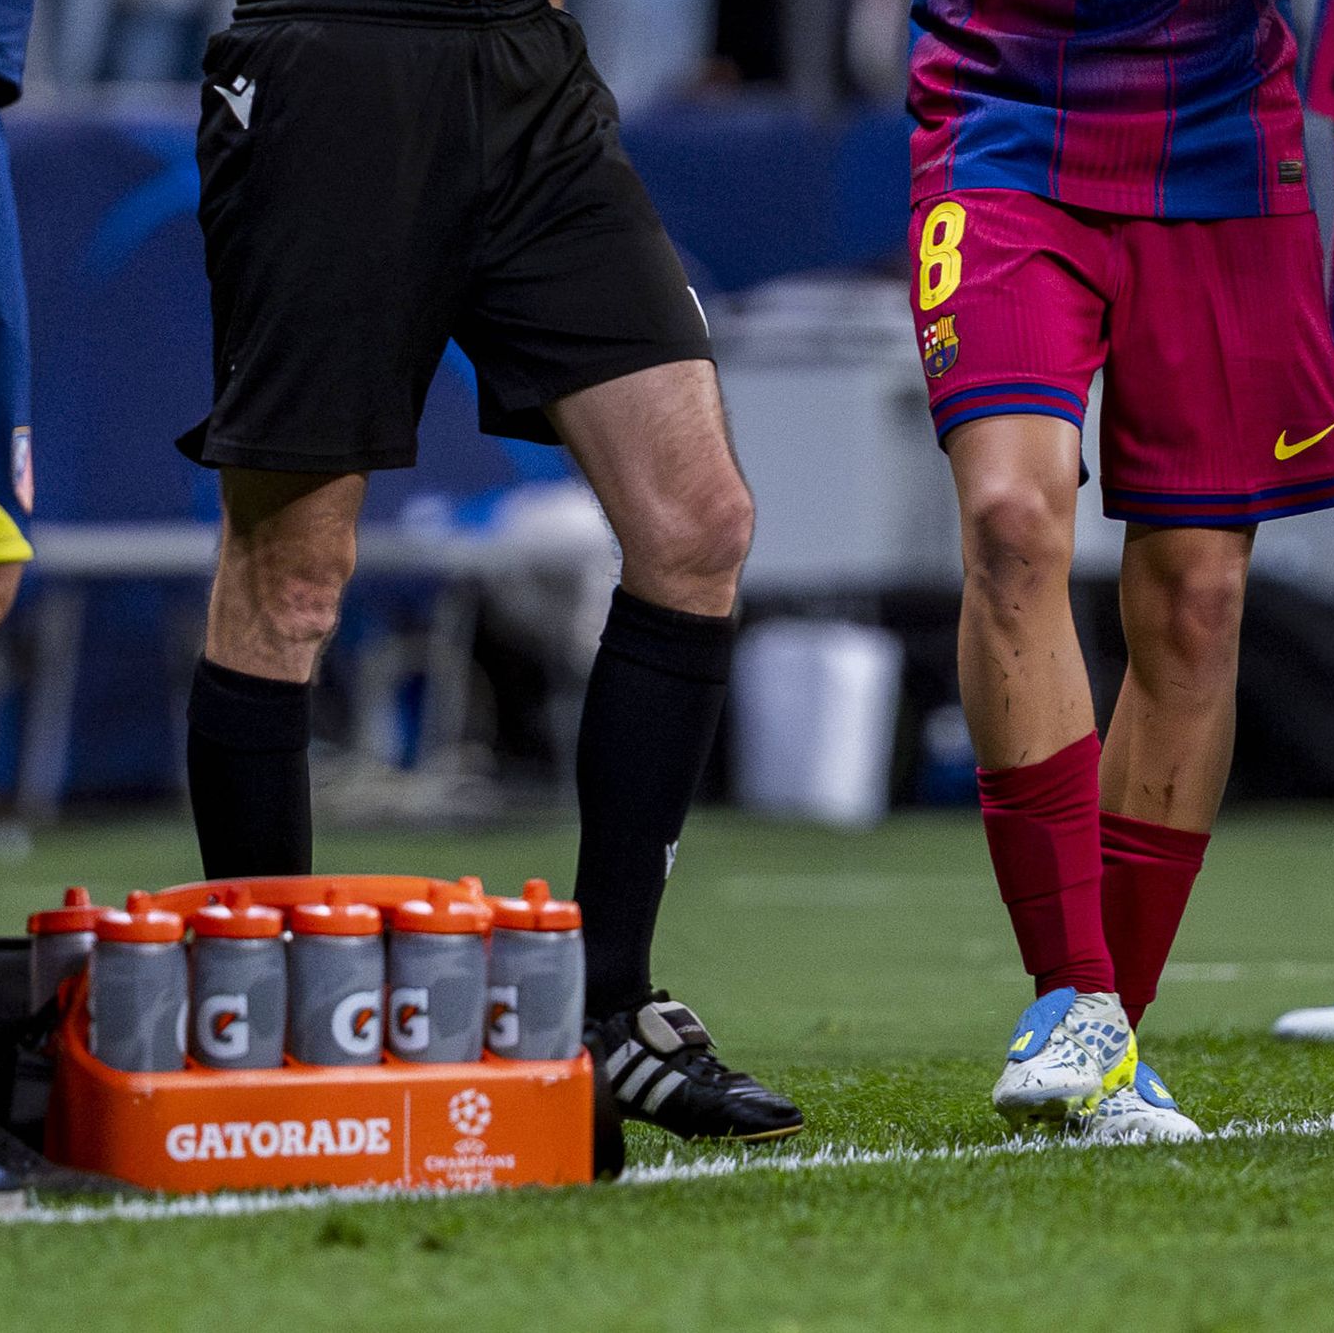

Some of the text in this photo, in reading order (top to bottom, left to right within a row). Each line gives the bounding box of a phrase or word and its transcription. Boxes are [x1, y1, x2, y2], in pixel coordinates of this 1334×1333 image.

[919, 201, 967, 312] 8
[196, 993, 250, 1060] G
[331, 989, 383, 1055] G
[389, 986, 431, 1053] G
[165, 1118, 392, 1162] GATORADE
[424, 1154, 516, 1173] CHAMPIONS
